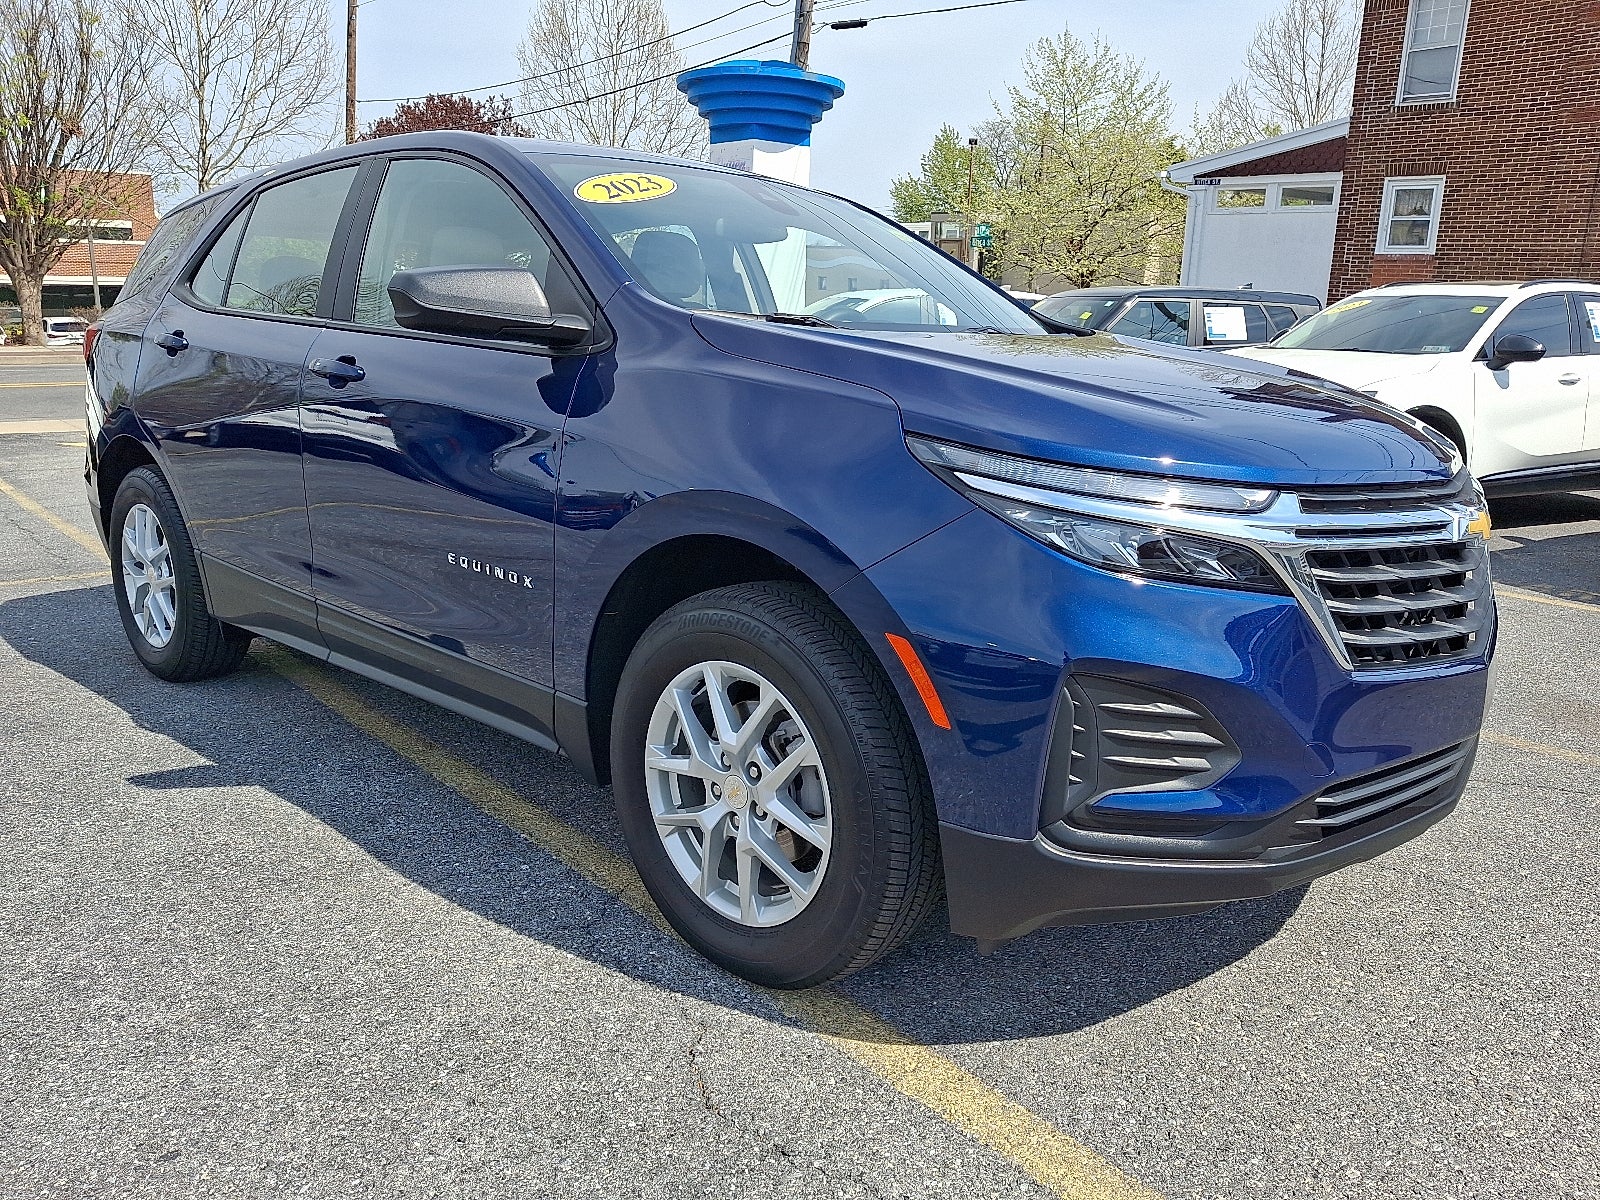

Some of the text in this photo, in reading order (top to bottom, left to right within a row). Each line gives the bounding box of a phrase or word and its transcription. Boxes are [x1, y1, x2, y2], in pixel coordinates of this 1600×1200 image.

[592, 176, 663, 200] 2023
[447, 552, 534, 589] EQUINOX
[677, 611, 771, 644] BRIDGESTONE
